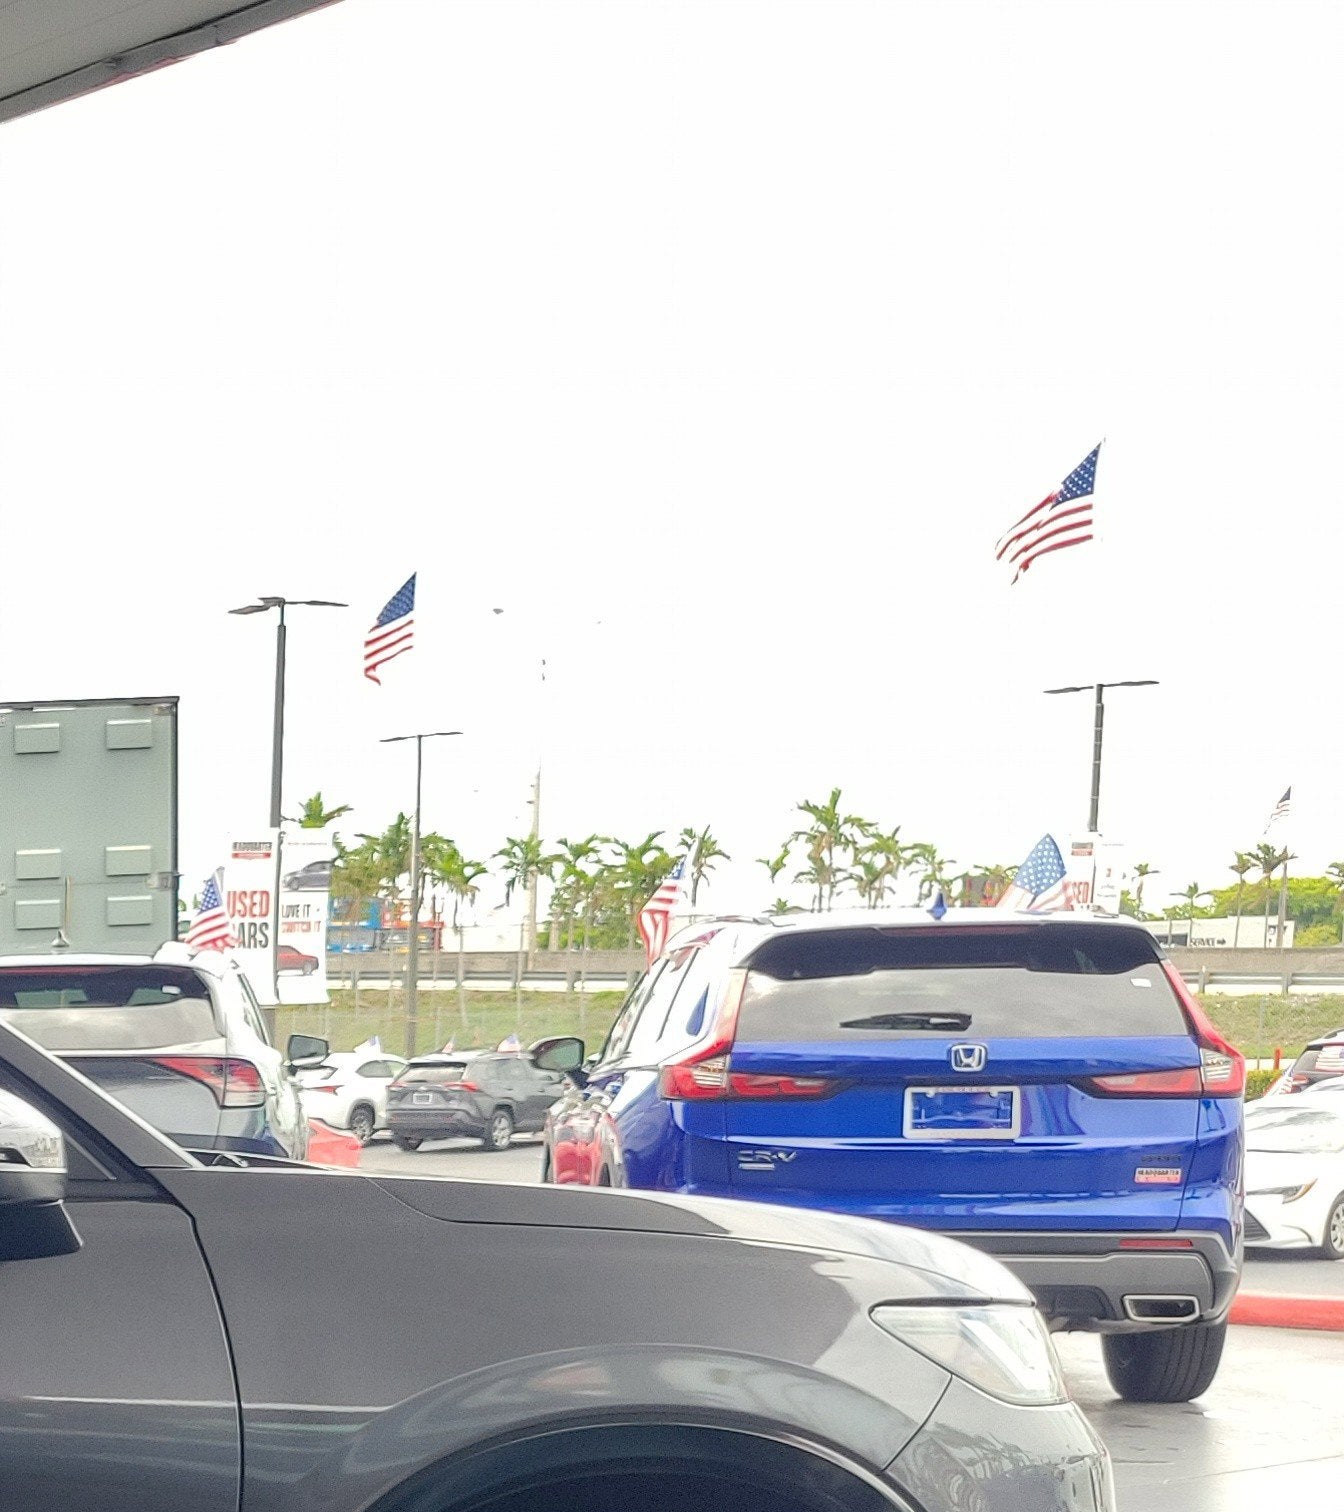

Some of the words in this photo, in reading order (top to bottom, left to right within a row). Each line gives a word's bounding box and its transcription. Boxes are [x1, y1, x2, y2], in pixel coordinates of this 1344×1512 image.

[227, 890, 271, 919] USED
[281, 904, 300, 919] LOVE
[302, 904, 311, 918] IT
[313, 920, 322, 933] IT
[232, 922, 270, 949] ARS
[737, 1150, 797, 1162] CR-V
